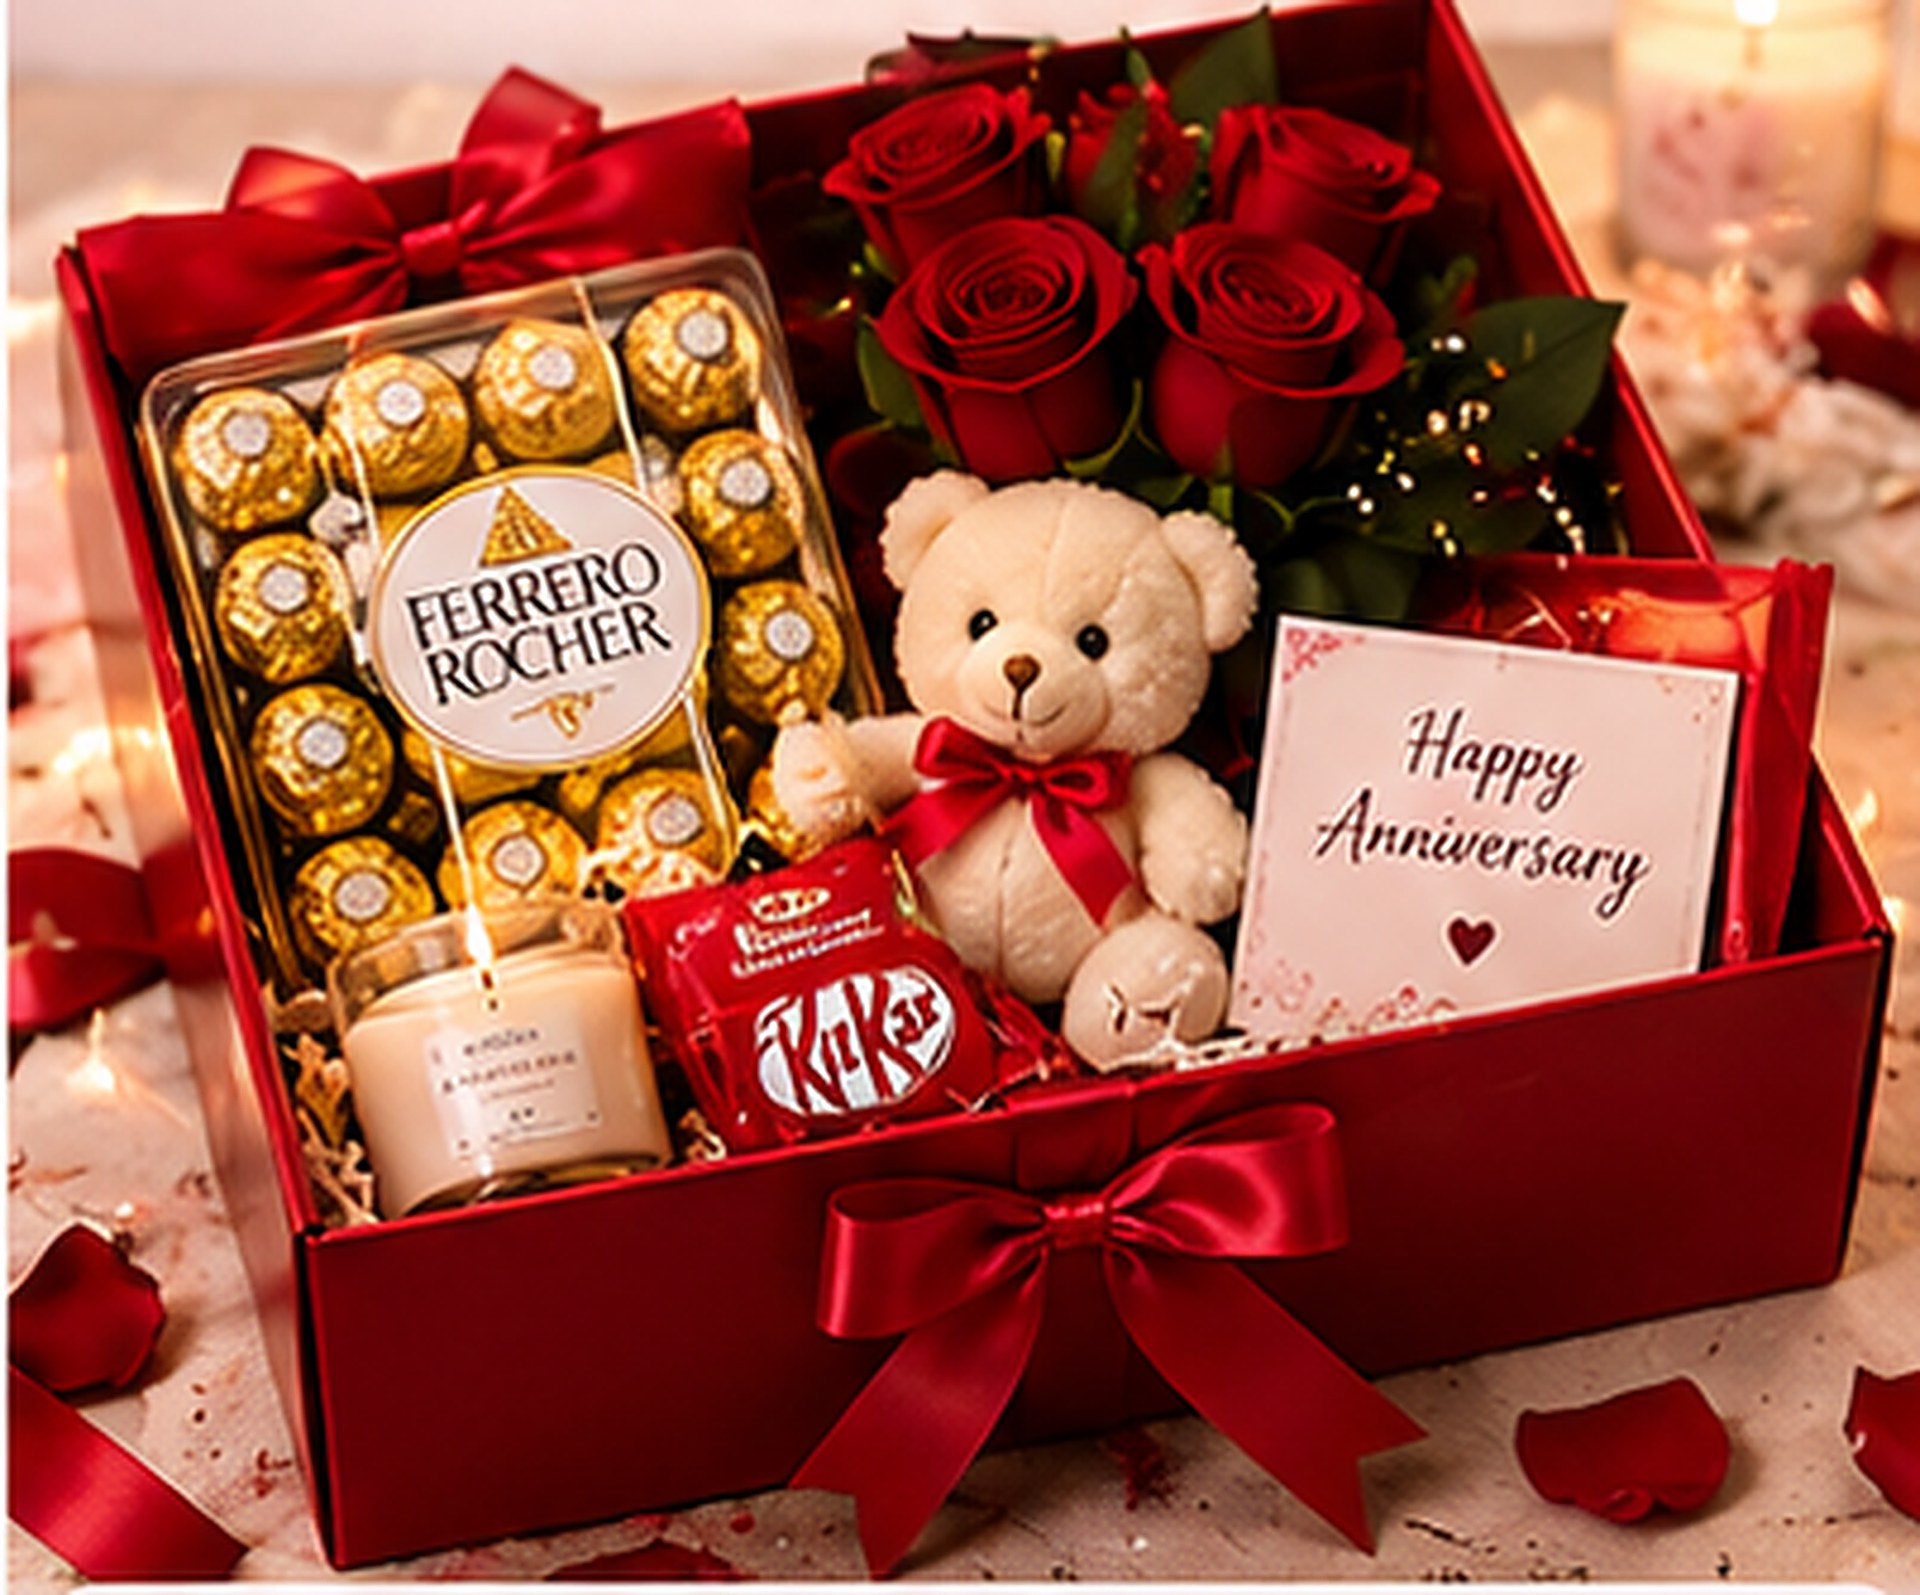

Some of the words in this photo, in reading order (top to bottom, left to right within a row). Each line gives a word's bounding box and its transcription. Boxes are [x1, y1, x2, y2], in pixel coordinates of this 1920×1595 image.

[406, 543, 660, 650] FERRERO
[426, 602, 672, 706] ROCHER
[1407, 708, 1582, 813] Happy
[1316, 788, 1651, 920] Anniversary
